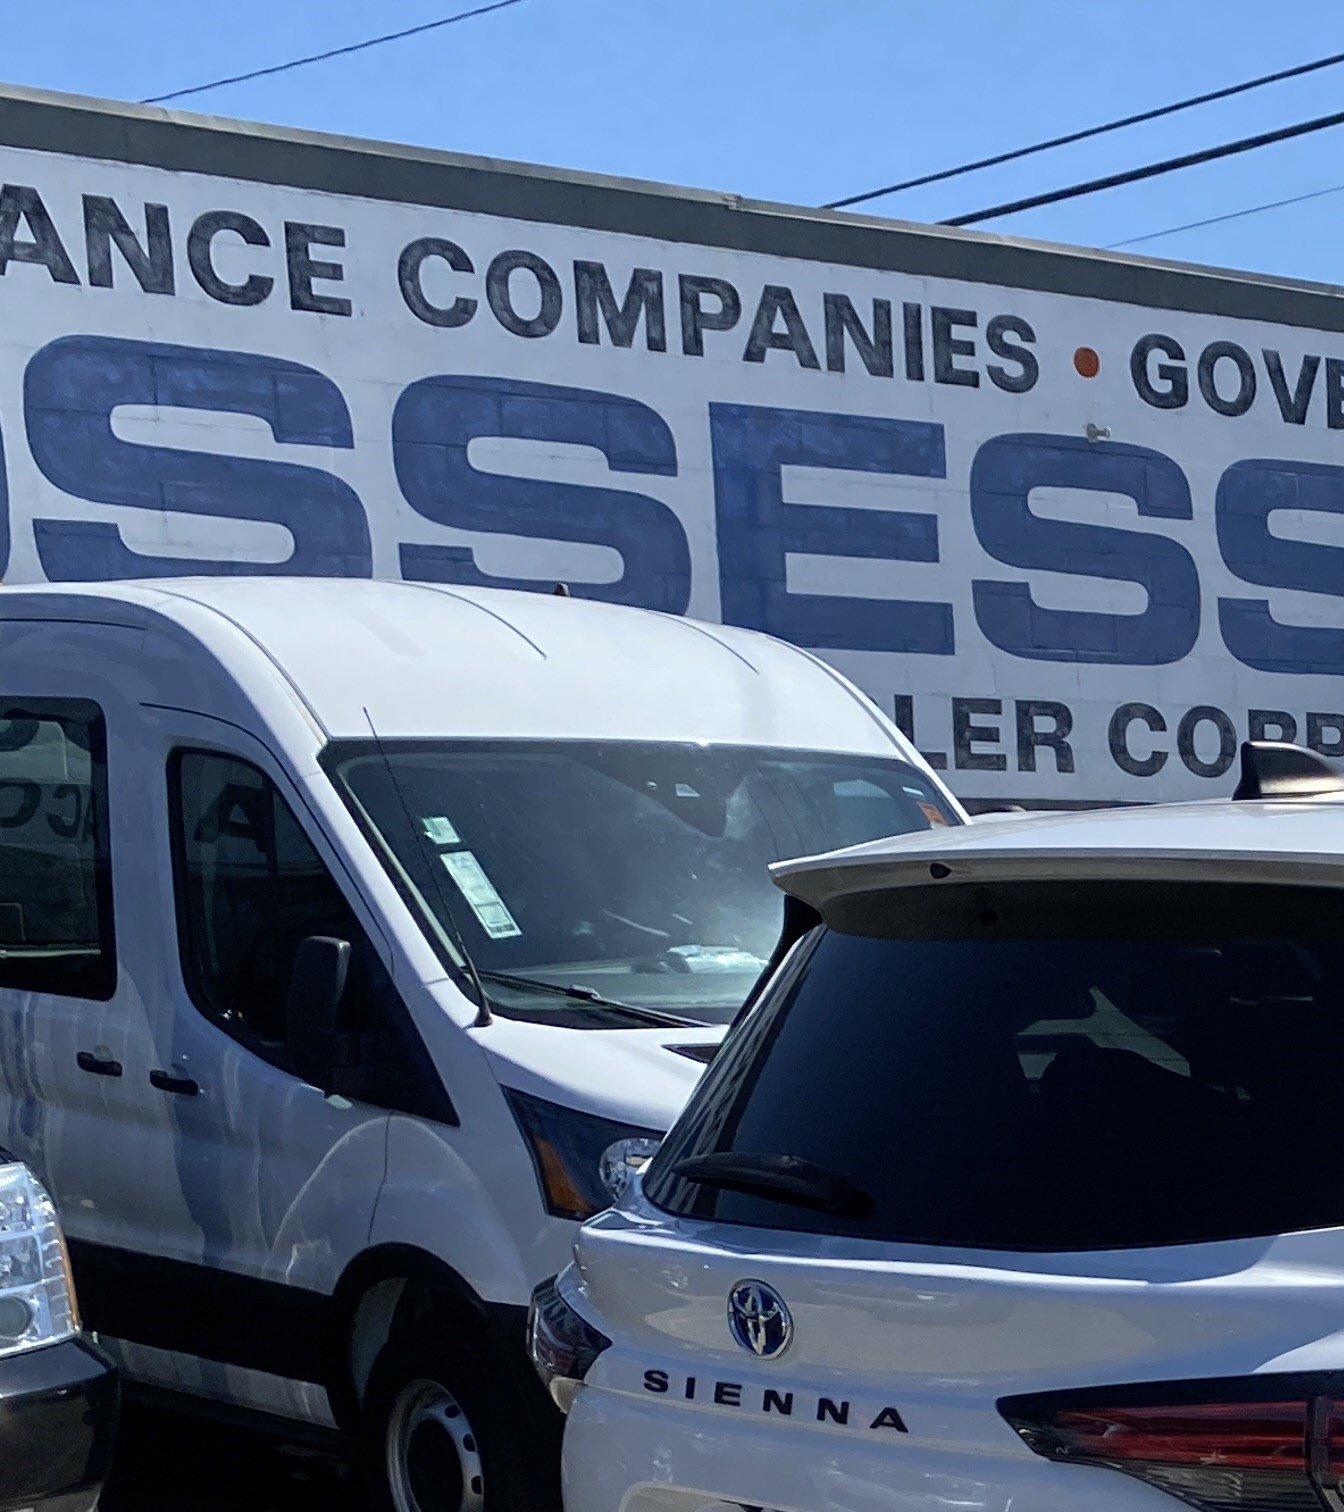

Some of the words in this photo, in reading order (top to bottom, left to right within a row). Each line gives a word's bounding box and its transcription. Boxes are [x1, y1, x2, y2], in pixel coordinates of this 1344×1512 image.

[0, 183, 352, 317] ANCE
[397, 236, 1039, 393] COMPANIES
[643, 1369, 909, 1433] SIENNA
